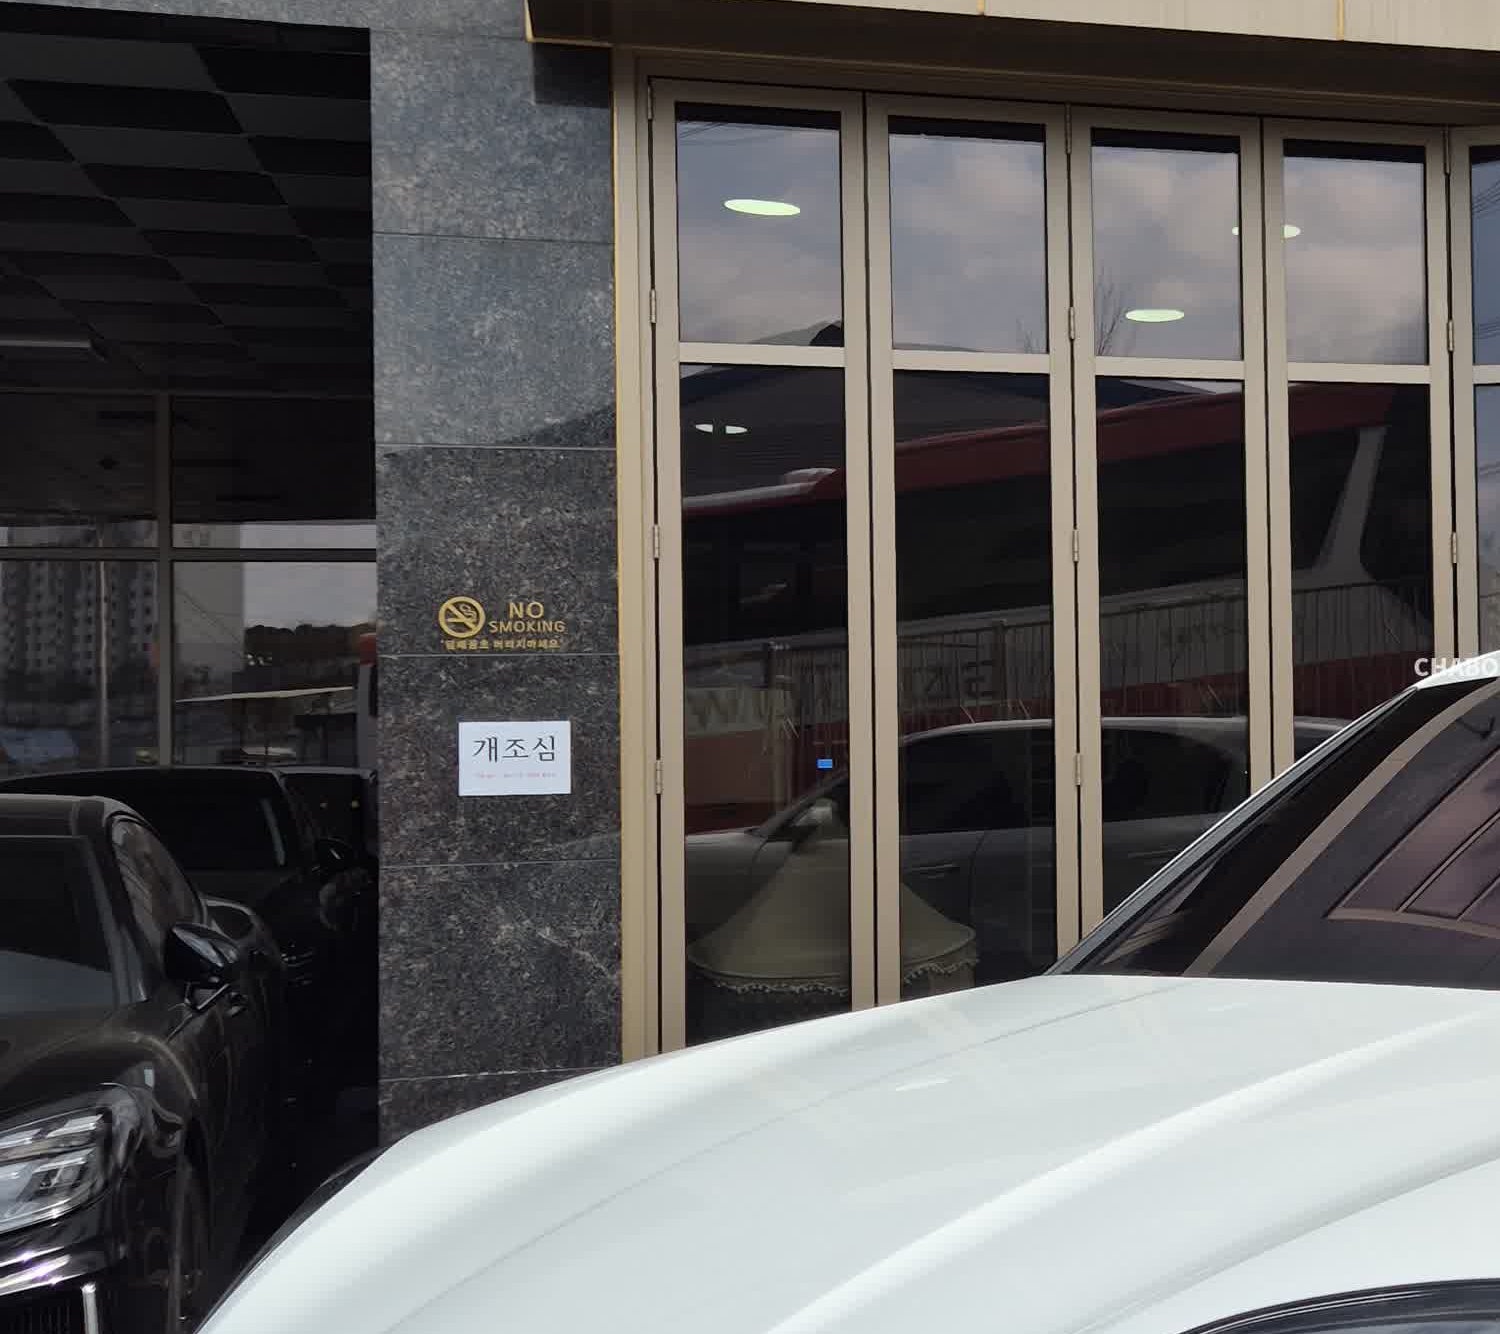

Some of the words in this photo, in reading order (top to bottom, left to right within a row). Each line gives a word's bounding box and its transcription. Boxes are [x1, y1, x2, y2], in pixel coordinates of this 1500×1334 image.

[508, 601, 545, 619] NO
[488, 620, 567, 634] SMOKING
[472, 735, 556, 763] 개조심
